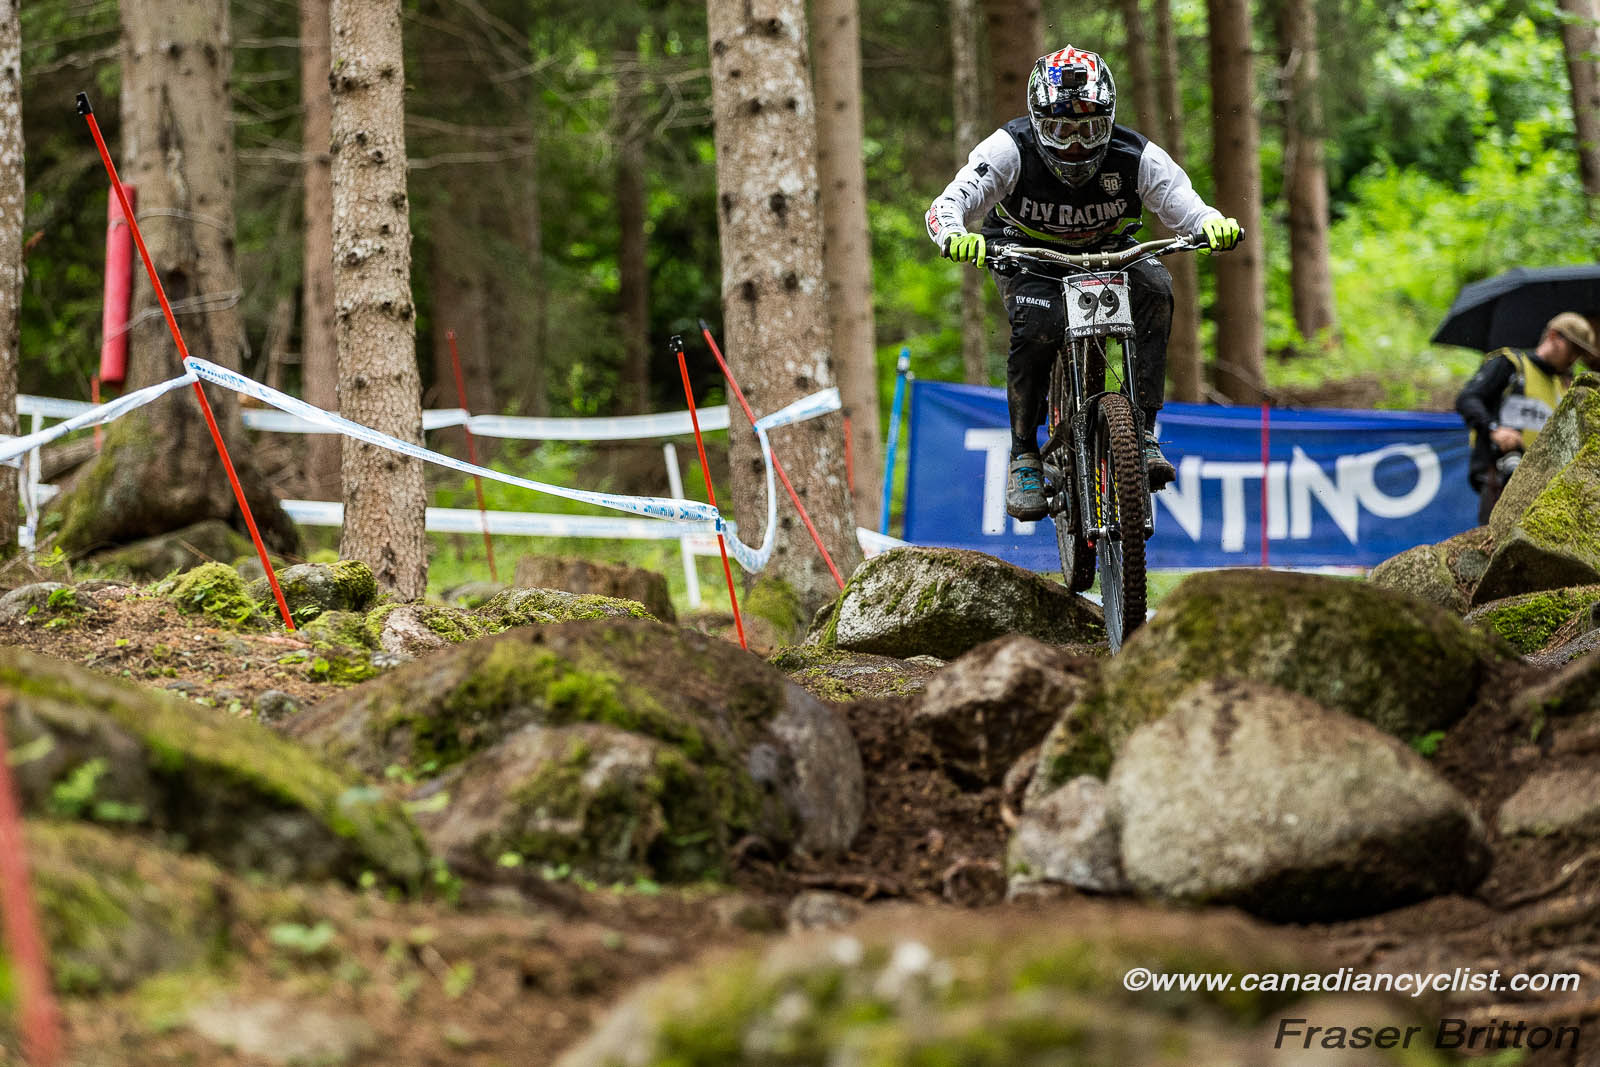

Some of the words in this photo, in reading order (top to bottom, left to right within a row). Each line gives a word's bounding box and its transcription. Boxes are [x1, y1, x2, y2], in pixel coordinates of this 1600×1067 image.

[1103, 179, 1119, 191] 98
[1020, 196, 1055, 222] FLY
[1059, 199, 1128, 225] RACING
[1025, 296, 1051, 309] RACING
[1077, 289, 1120, 321] 99
[964, 427, 1442, 553] TNTINO
